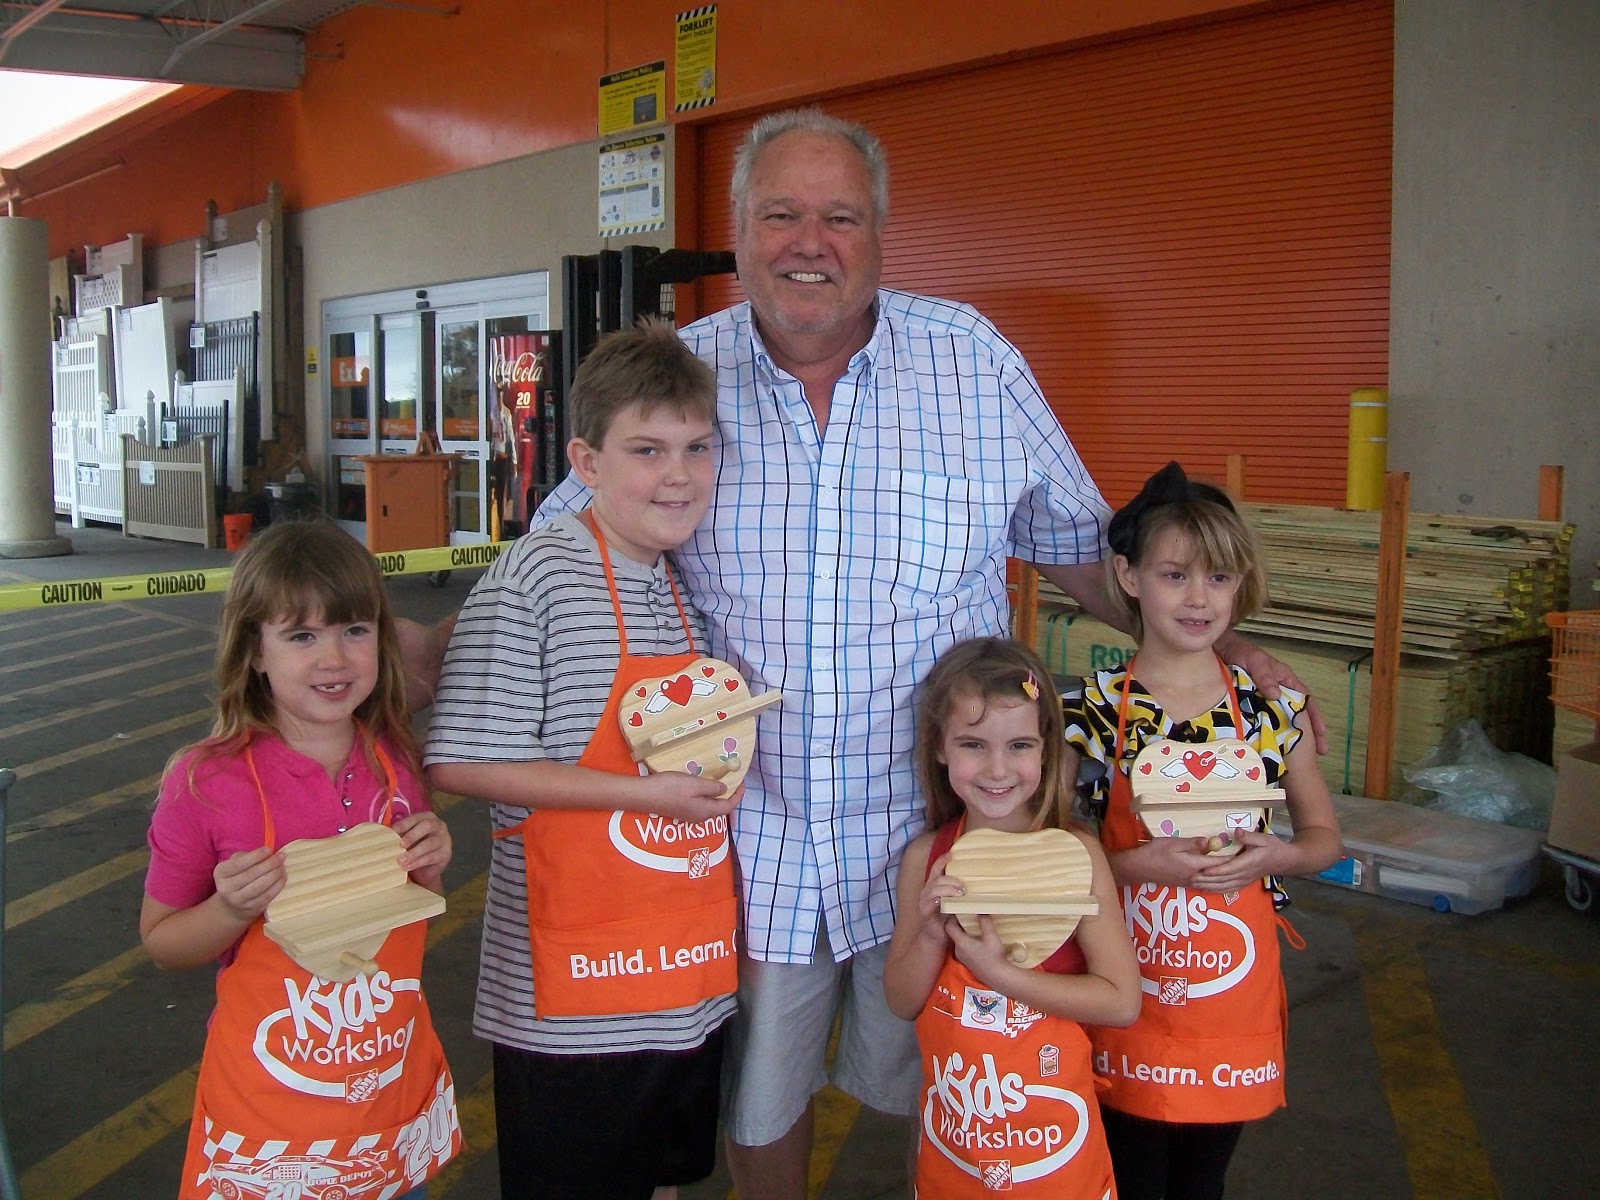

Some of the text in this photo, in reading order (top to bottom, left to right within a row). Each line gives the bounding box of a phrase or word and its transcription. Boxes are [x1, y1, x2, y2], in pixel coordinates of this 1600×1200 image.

[679, 16, 713, 34] FORKLIFT
[516, 392, 531, 406] 20
[451, 545, 501, 566] CAUTION
[41, 572, 206, 604] CAUTION CUIDADO
[690, 849, 709, 878] HOME
[1123, 881, 1209, 949] Kids
[569, 948, 653, 980] Build.
[659, 938, 730, 972] Learn.
[1133, 938, 1232, 975] orkshop
[1160, 979, 1185, 1003] HOME
[1162, 980, 1173, 991] THE
[284, 970, 394, 1050] Kids
[1007, 1012, 1043, 1024] RACING
[281, 1025, 406, 1065] Worksho
[347, 1069, 378, 1102] HOME
[350, 1077, 364, 1089] THE
[1121, 1054, 1204, 1086] Learn.
[1211, 1060, 1280, 1088] Create.
[360, 1080, 377, 1100] DEPOT
[932, 1051, 1028, 1132] Kids
[407, 1092, 452, 1180] 20
[939, 1106, 1063, 1154] Workshop
[307, 1170, 373, 1187] HOME DEPOT
[984, 1164, 995, 1176] THE
[984, 1160, 1009, 1189] HOME
[993, 1171, 1010, 1190] DEPOT
[266, 1181, 303, 1200] 20
